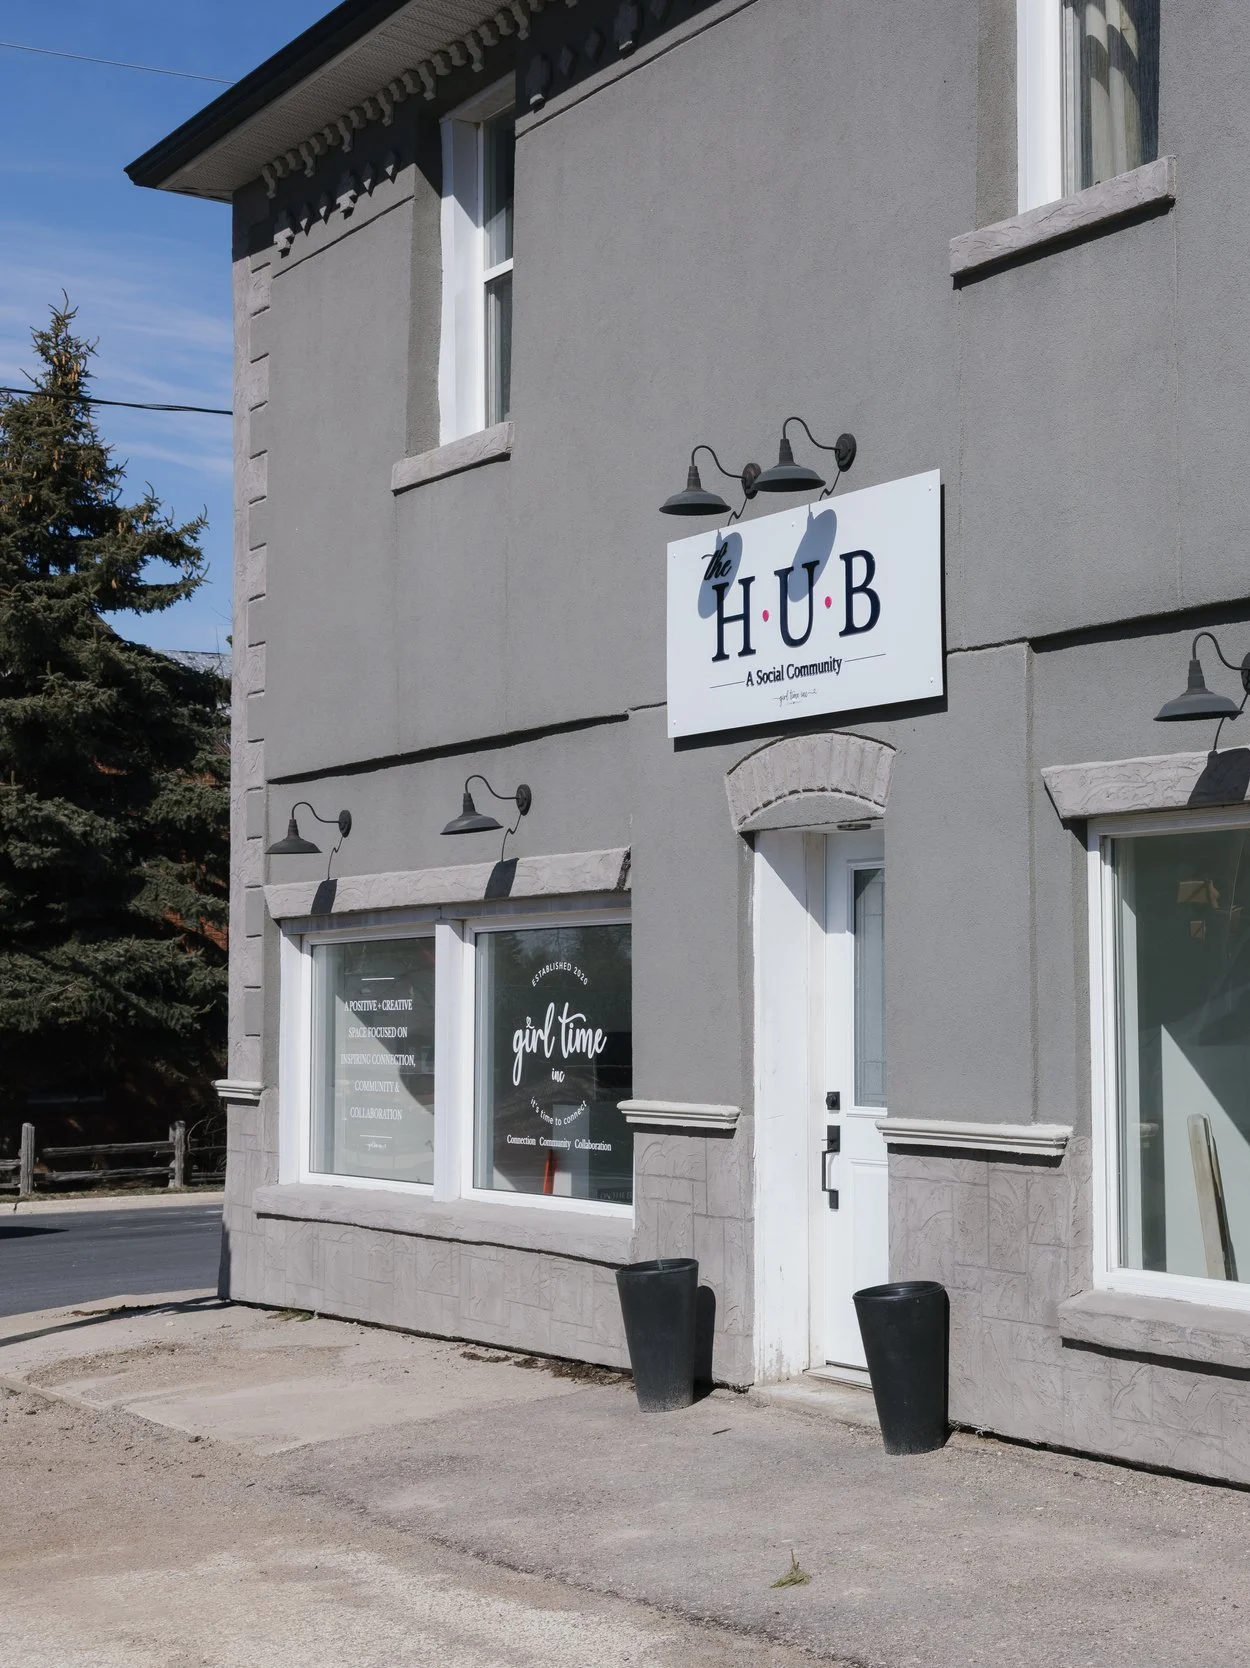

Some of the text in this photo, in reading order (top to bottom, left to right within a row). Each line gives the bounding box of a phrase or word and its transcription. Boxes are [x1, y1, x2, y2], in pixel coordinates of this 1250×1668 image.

[701, 542, 732, 581] the
[746, 656, 842, 687] A Social Community
[531, 961, 588, 987] ESTABLISHED 2020
[344, 1001, 349, 1011] A
[349, 1000, 377, 1011] POSITIVE
[382, 999, 412, 1011] CREATIVE
[348, 1026, 408, 1038] SPACE FOCUSED ON
[512, 1001, 607, 1086] girl time
[341, 1053, 416, 1068] INSPIRING CONNECTION,
[551, 1067, 565, 1083] inc
[354, 1080, 400, 1093] COMMUNITY &
[350, 1106, 403, 1121] COLLABORATION
[530, 1096, 587, 1126] it's time to connect
[507, 1133, 612, 1151] Connection Community Collaboration
